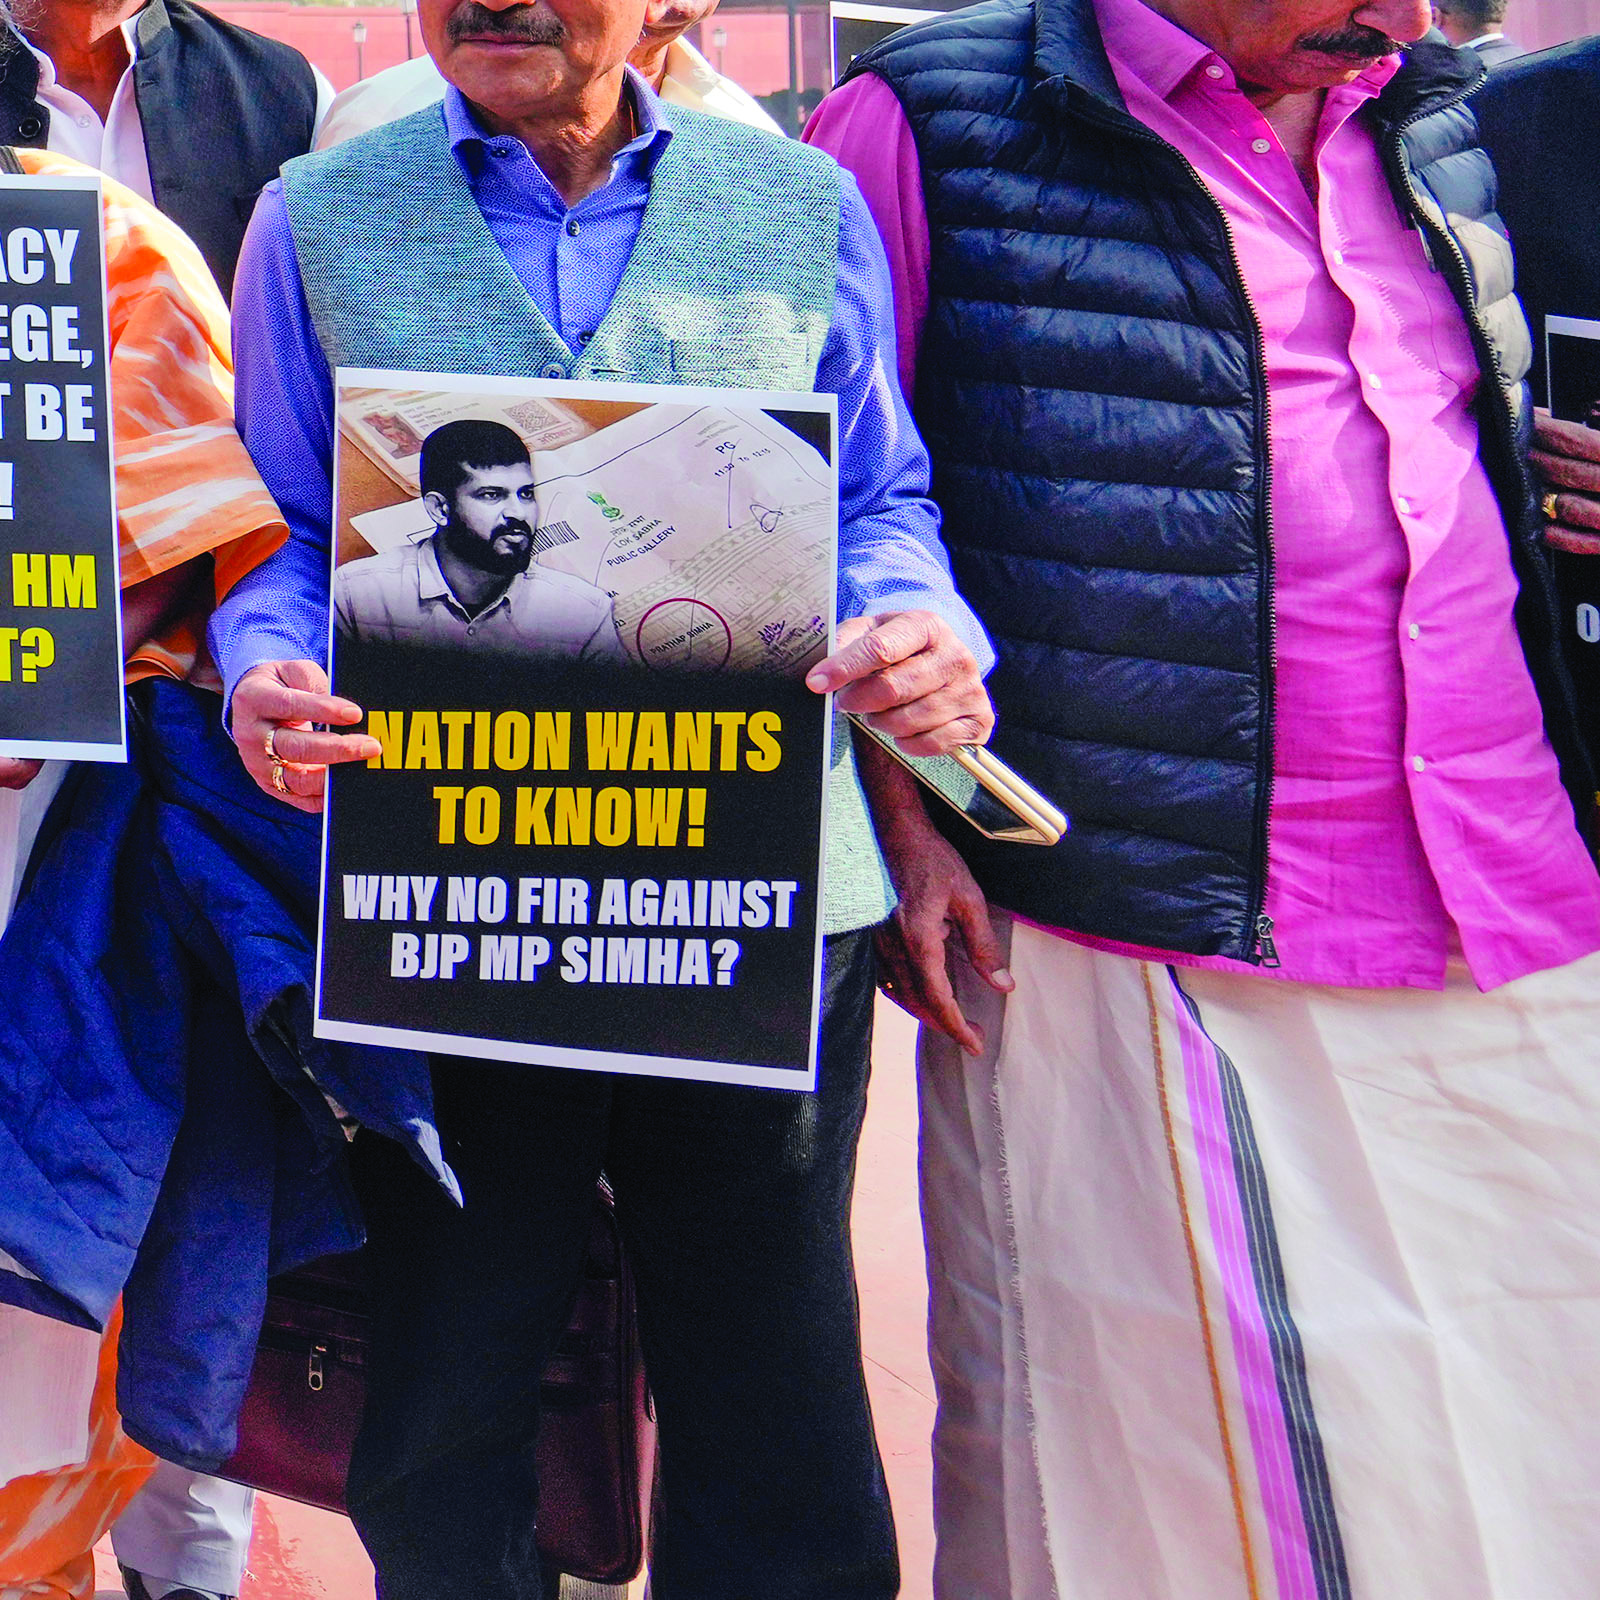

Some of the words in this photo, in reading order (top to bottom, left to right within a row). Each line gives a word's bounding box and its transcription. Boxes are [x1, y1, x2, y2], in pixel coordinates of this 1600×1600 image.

[24, 383, 96, 442] BE
[715, 441, 737, 454] PG
[606, 550, 638, 567] PUBLIC
[637, 525, 677, 554] GALLERY
[614, 537, 633, 549] LOK
[632, 519, 662, 540] SABHA
[11, 552, 98, 609] HM
[650, 635, 686, 655] PRATHAP
[686, 622, 714, 638] SIMHA
[366, 710, 572, 771] NATION
[585, 711, 782, 772] WANTS
[432, 785, 501, 846] TO
[514, 786, 707, 848] KNOW!
[342, 874, 438, 922] WHY
[446, 876, 507, 923] NO
[517, 877, 589, 925] FIR
[597, 878, 797, 928] AGAINST
[390, 932, 469, 979] BJP
[479, 934, 550, 982] MP
[560, 936, 739, 986] SIMHA?
